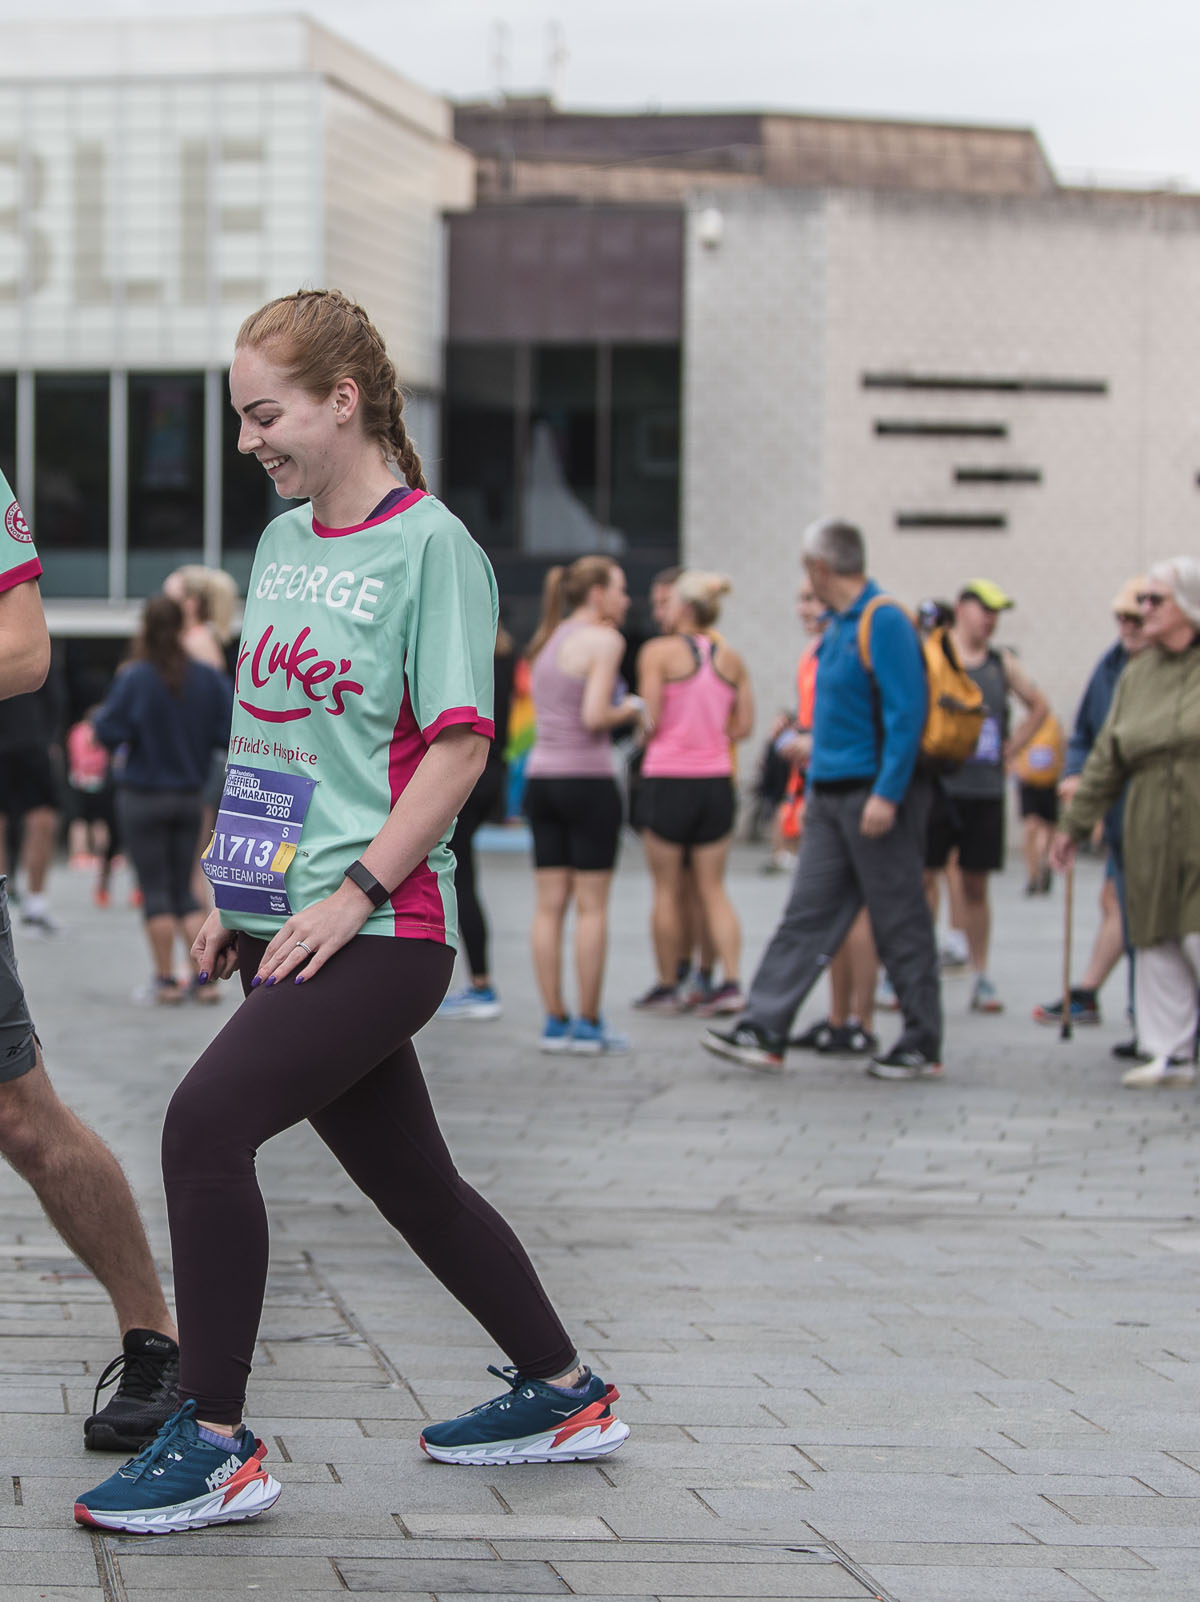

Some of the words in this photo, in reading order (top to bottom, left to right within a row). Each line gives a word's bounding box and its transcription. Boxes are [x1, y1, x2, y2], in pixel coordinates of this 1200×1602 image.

[256, 562, 385, 621] GEORGE
[251, 624, 364, 716] Luke's
[240, 789, 292, 806] MARATHON
[266, 805, 291, 818] 2020
[281, 827, 290, 838] S
[230, 868, 254, 883] TEAM
[256, 872, 274, 885] PPP
[205, 1454, 243, 1493] HOKA
